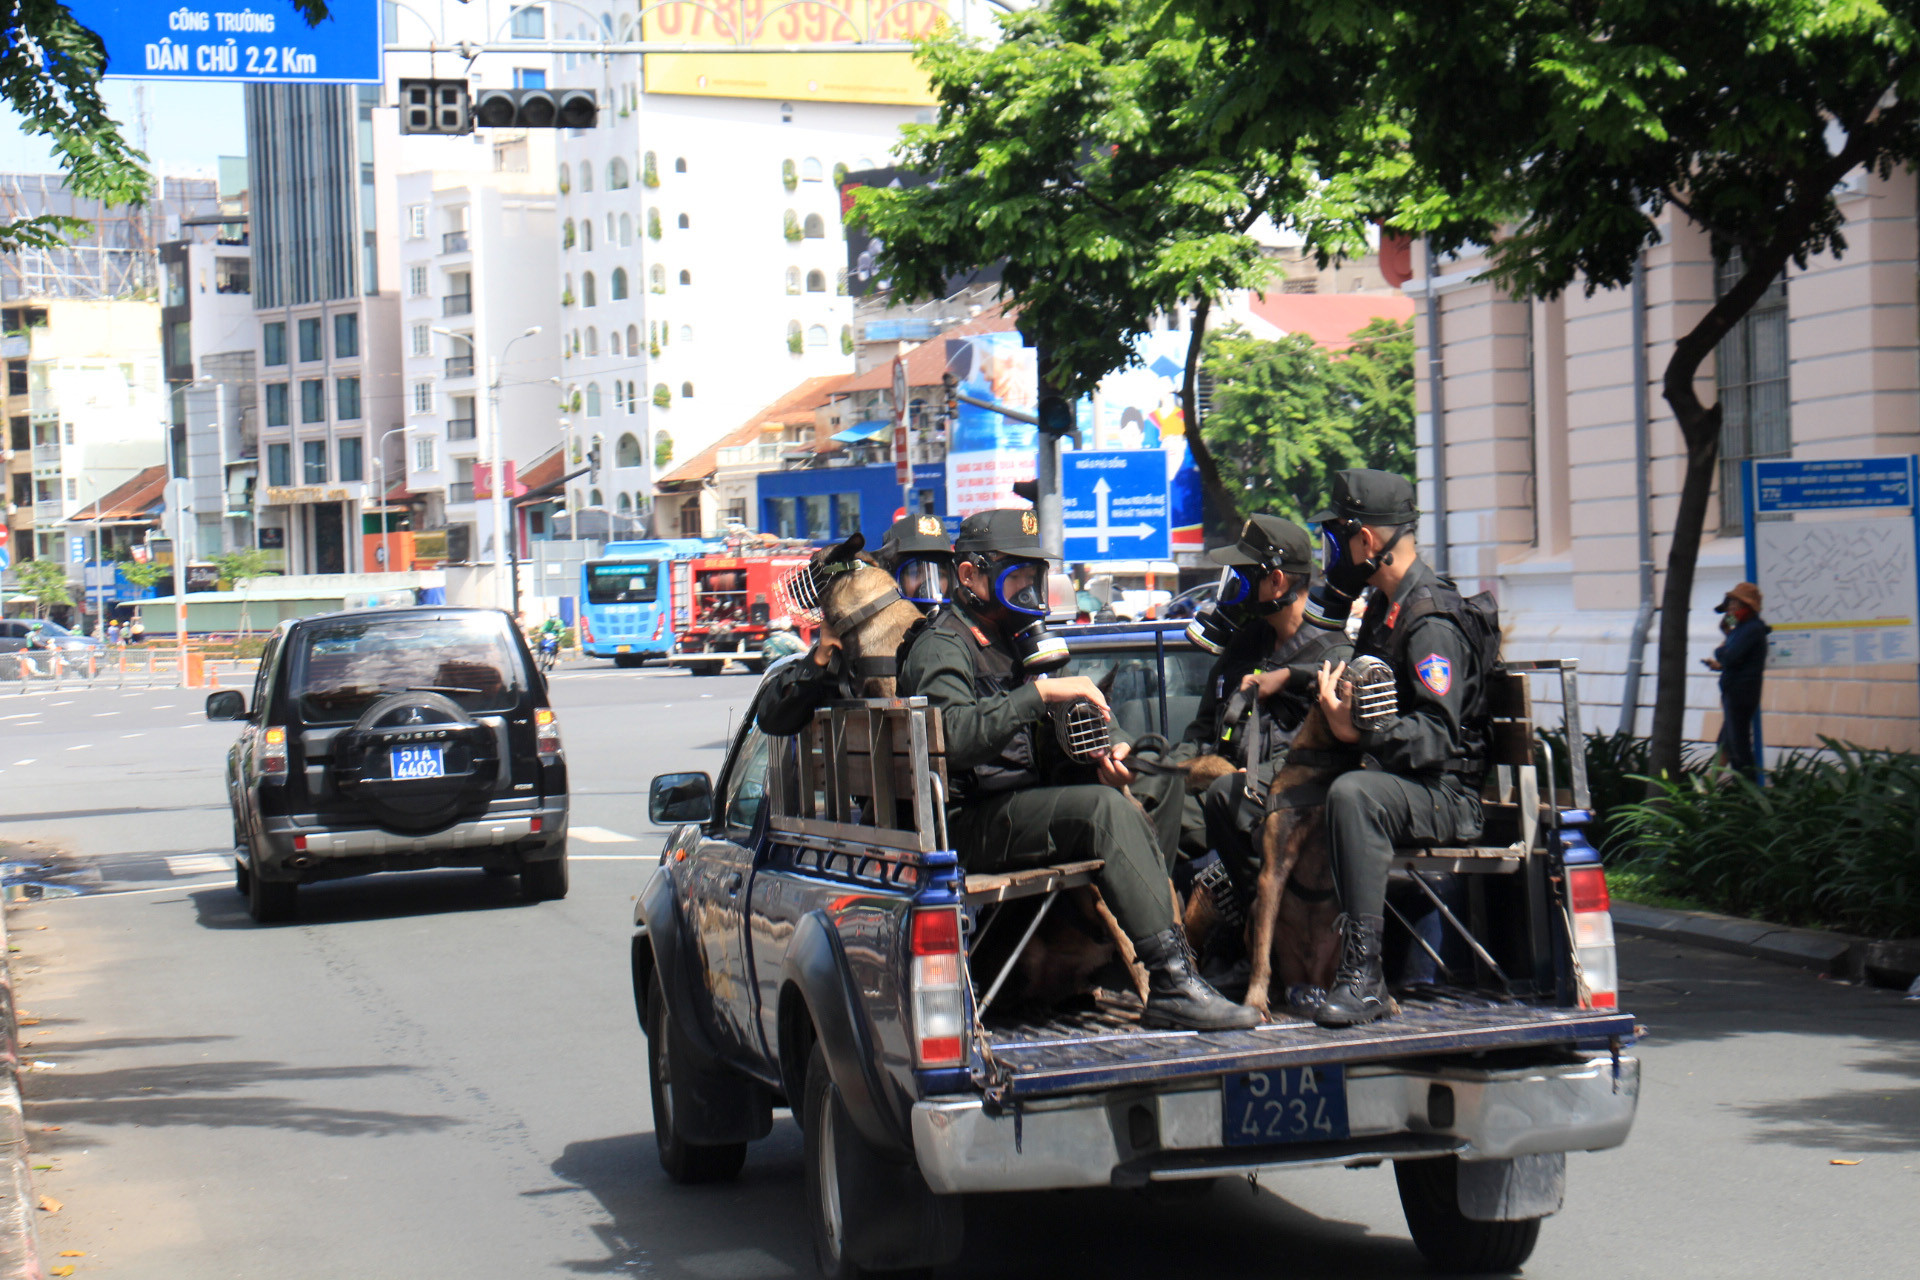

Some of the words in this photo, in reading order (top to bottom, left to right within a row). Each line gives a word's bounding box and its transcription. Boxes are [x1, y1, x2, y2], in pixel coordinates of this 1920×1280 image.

[168, 6, 210, 32] CÔNG
[145, 37, 189, 71] DÂN
[196, 38, 239, 73] CHỦ
[245, 46, 278, 75] 2,2
[281, 47, 317, 74] Km
[400, 746, 432, 762] 51A
[397, 760, 438, 777] 4402
[1248, 1066, 1319, 1097] 51A
[1240, 1097, 1333, 1137] 4234
